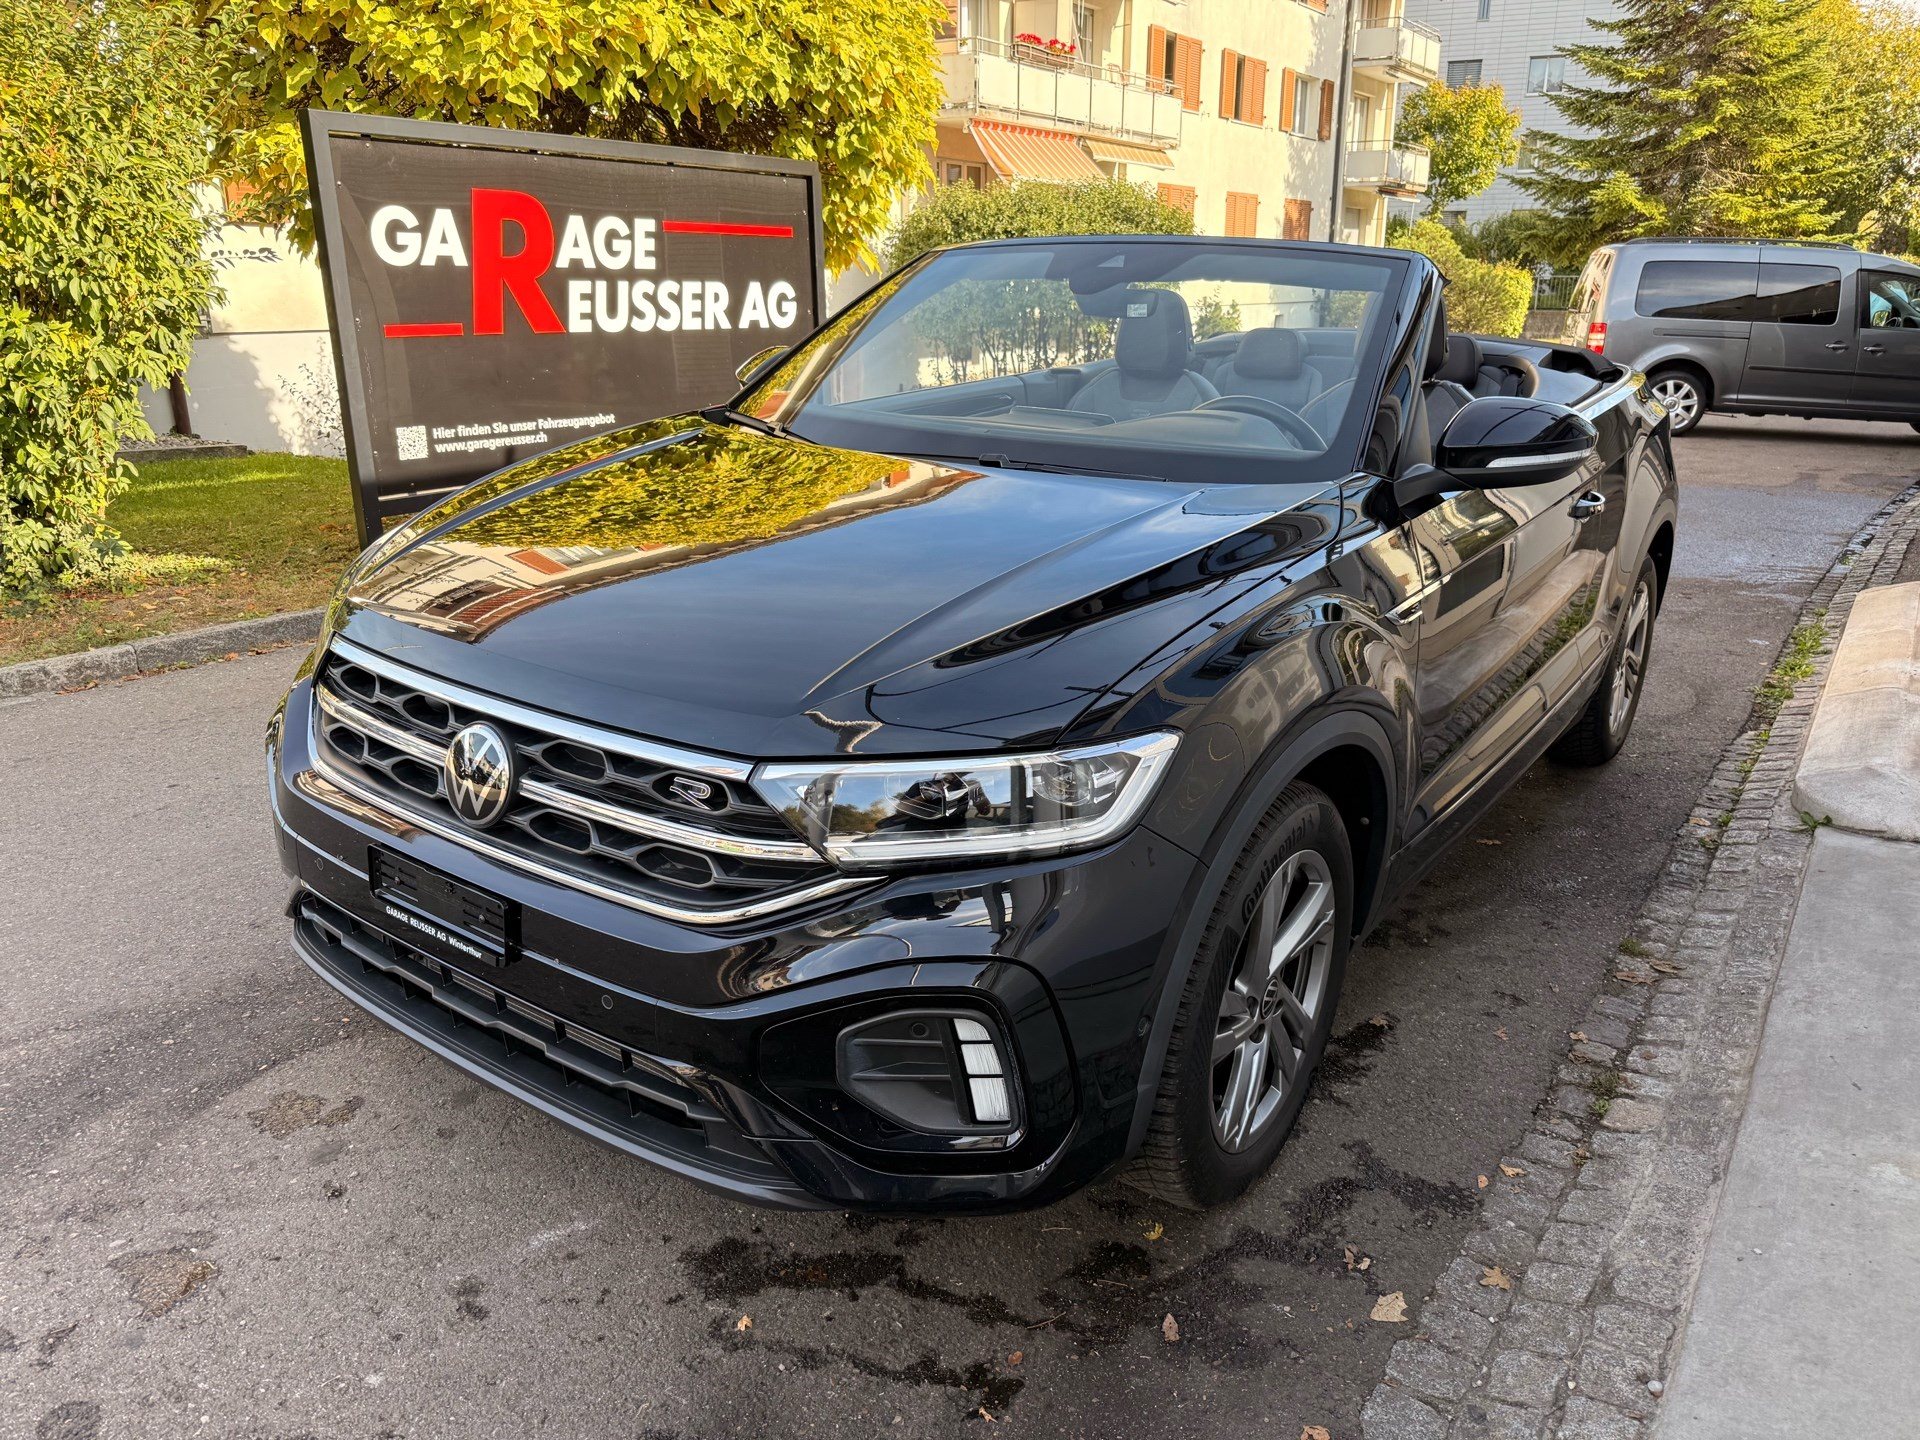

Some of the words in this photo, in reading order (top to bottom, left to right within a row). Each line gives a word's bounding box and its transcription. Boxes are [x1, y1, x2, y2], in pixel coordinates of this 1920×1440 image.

[371, 187, 656, 335] GARAGE
[738, 280, 798, 329] AG
[432, 427, 456, 439] Hier
[458, 422, 491, 436] finden
[493, 420, 509, 434] Sie
[510, 421, 537, 433] unser
[538, 413, 616, 430] Fahrzeugangebot
[434, 432, 547, 452] www.garagereusser.ch
[386, 906, 408, 923] GARAGE
[410, 918, 436, 936] REUSSER
[436, 931, 447, 942] AG
[449, 936, 482, 958] Winterthur
